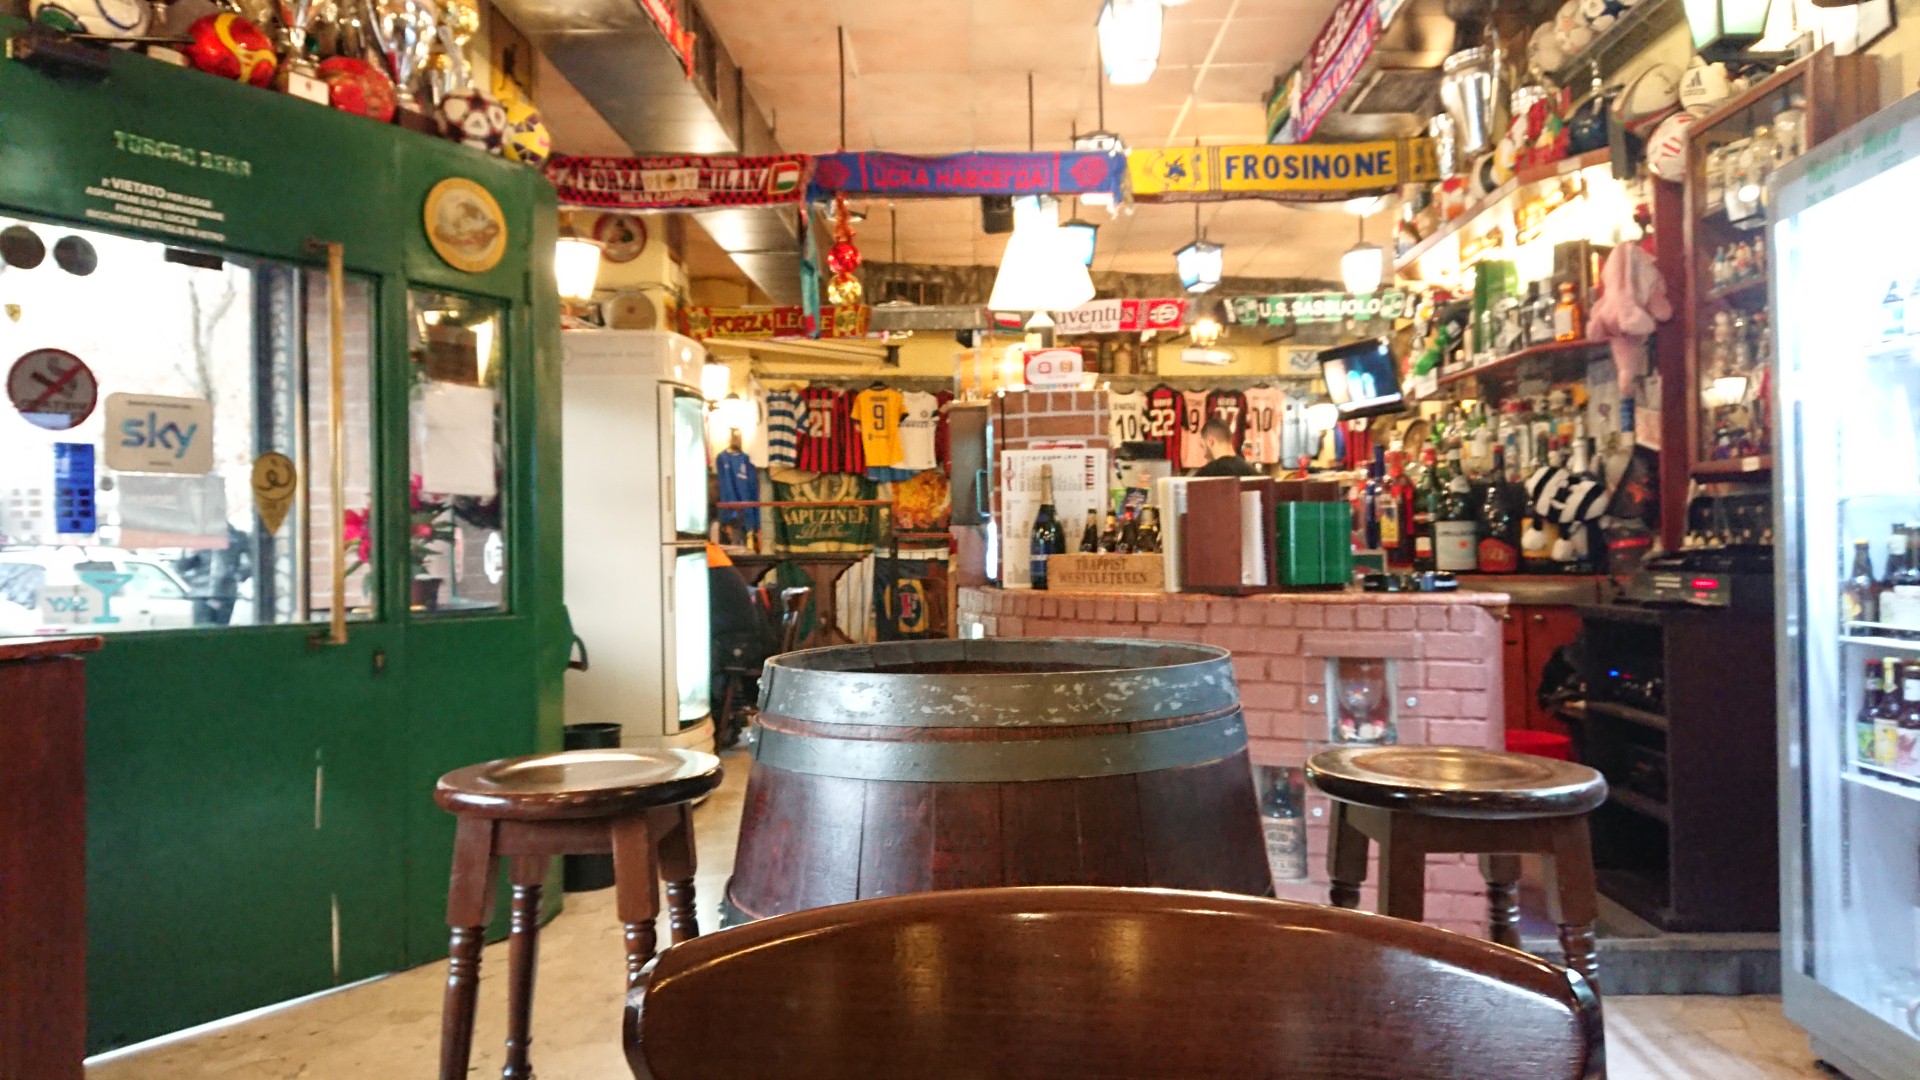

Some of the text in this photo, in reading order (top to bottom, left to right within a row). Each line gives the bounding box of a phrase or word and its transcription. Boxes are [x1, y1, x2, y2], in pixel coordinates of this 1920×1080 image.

[1224, 150, 1394, 180] FROSINONE
[110, 177, 166, 199] VIETATO
[699, 168, 769, 191] MILAN
[873, 168, 930, 190] ЦСКА
[776, 314, 832, 331] LECE
[809, 410, 832, 438] 21
[873, 404, 885, 430] 9
[1116, 413, 1137, 440] 10
[1150, 409, 1176, 437] 22
[1189, 409, 1200, 434] 9
[1250, 407, 1273, 432] 10
[121, 411, 197, 458] sky
